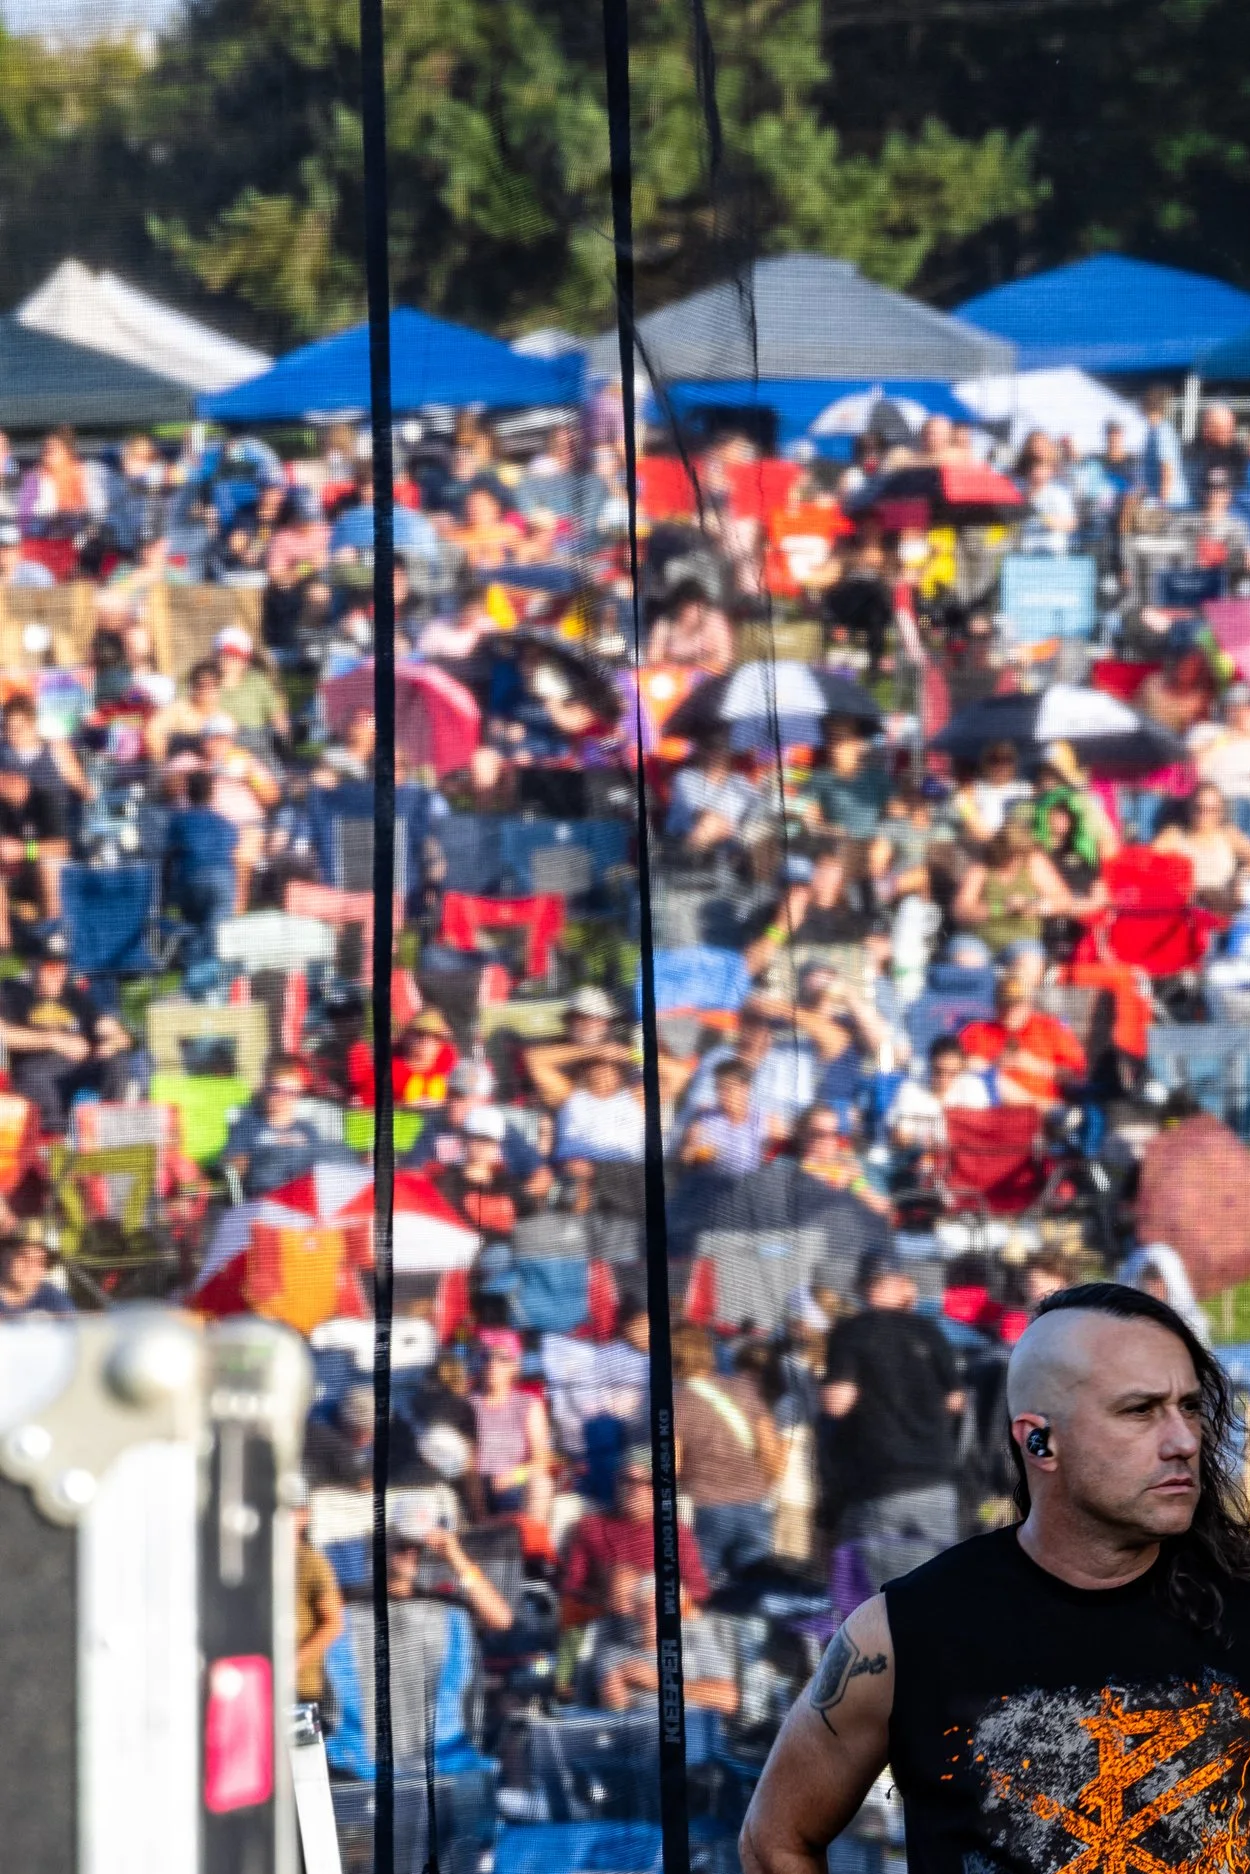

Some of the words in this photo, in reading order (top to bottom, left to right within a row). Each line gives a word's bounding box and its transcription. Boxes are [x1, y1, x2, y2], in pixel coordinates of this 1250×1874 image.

[661, 1487, 673, 1521] LBS
[663, 1578, 677, 1615] WLL
[661, 1638, 681, 1744] KEEPER
